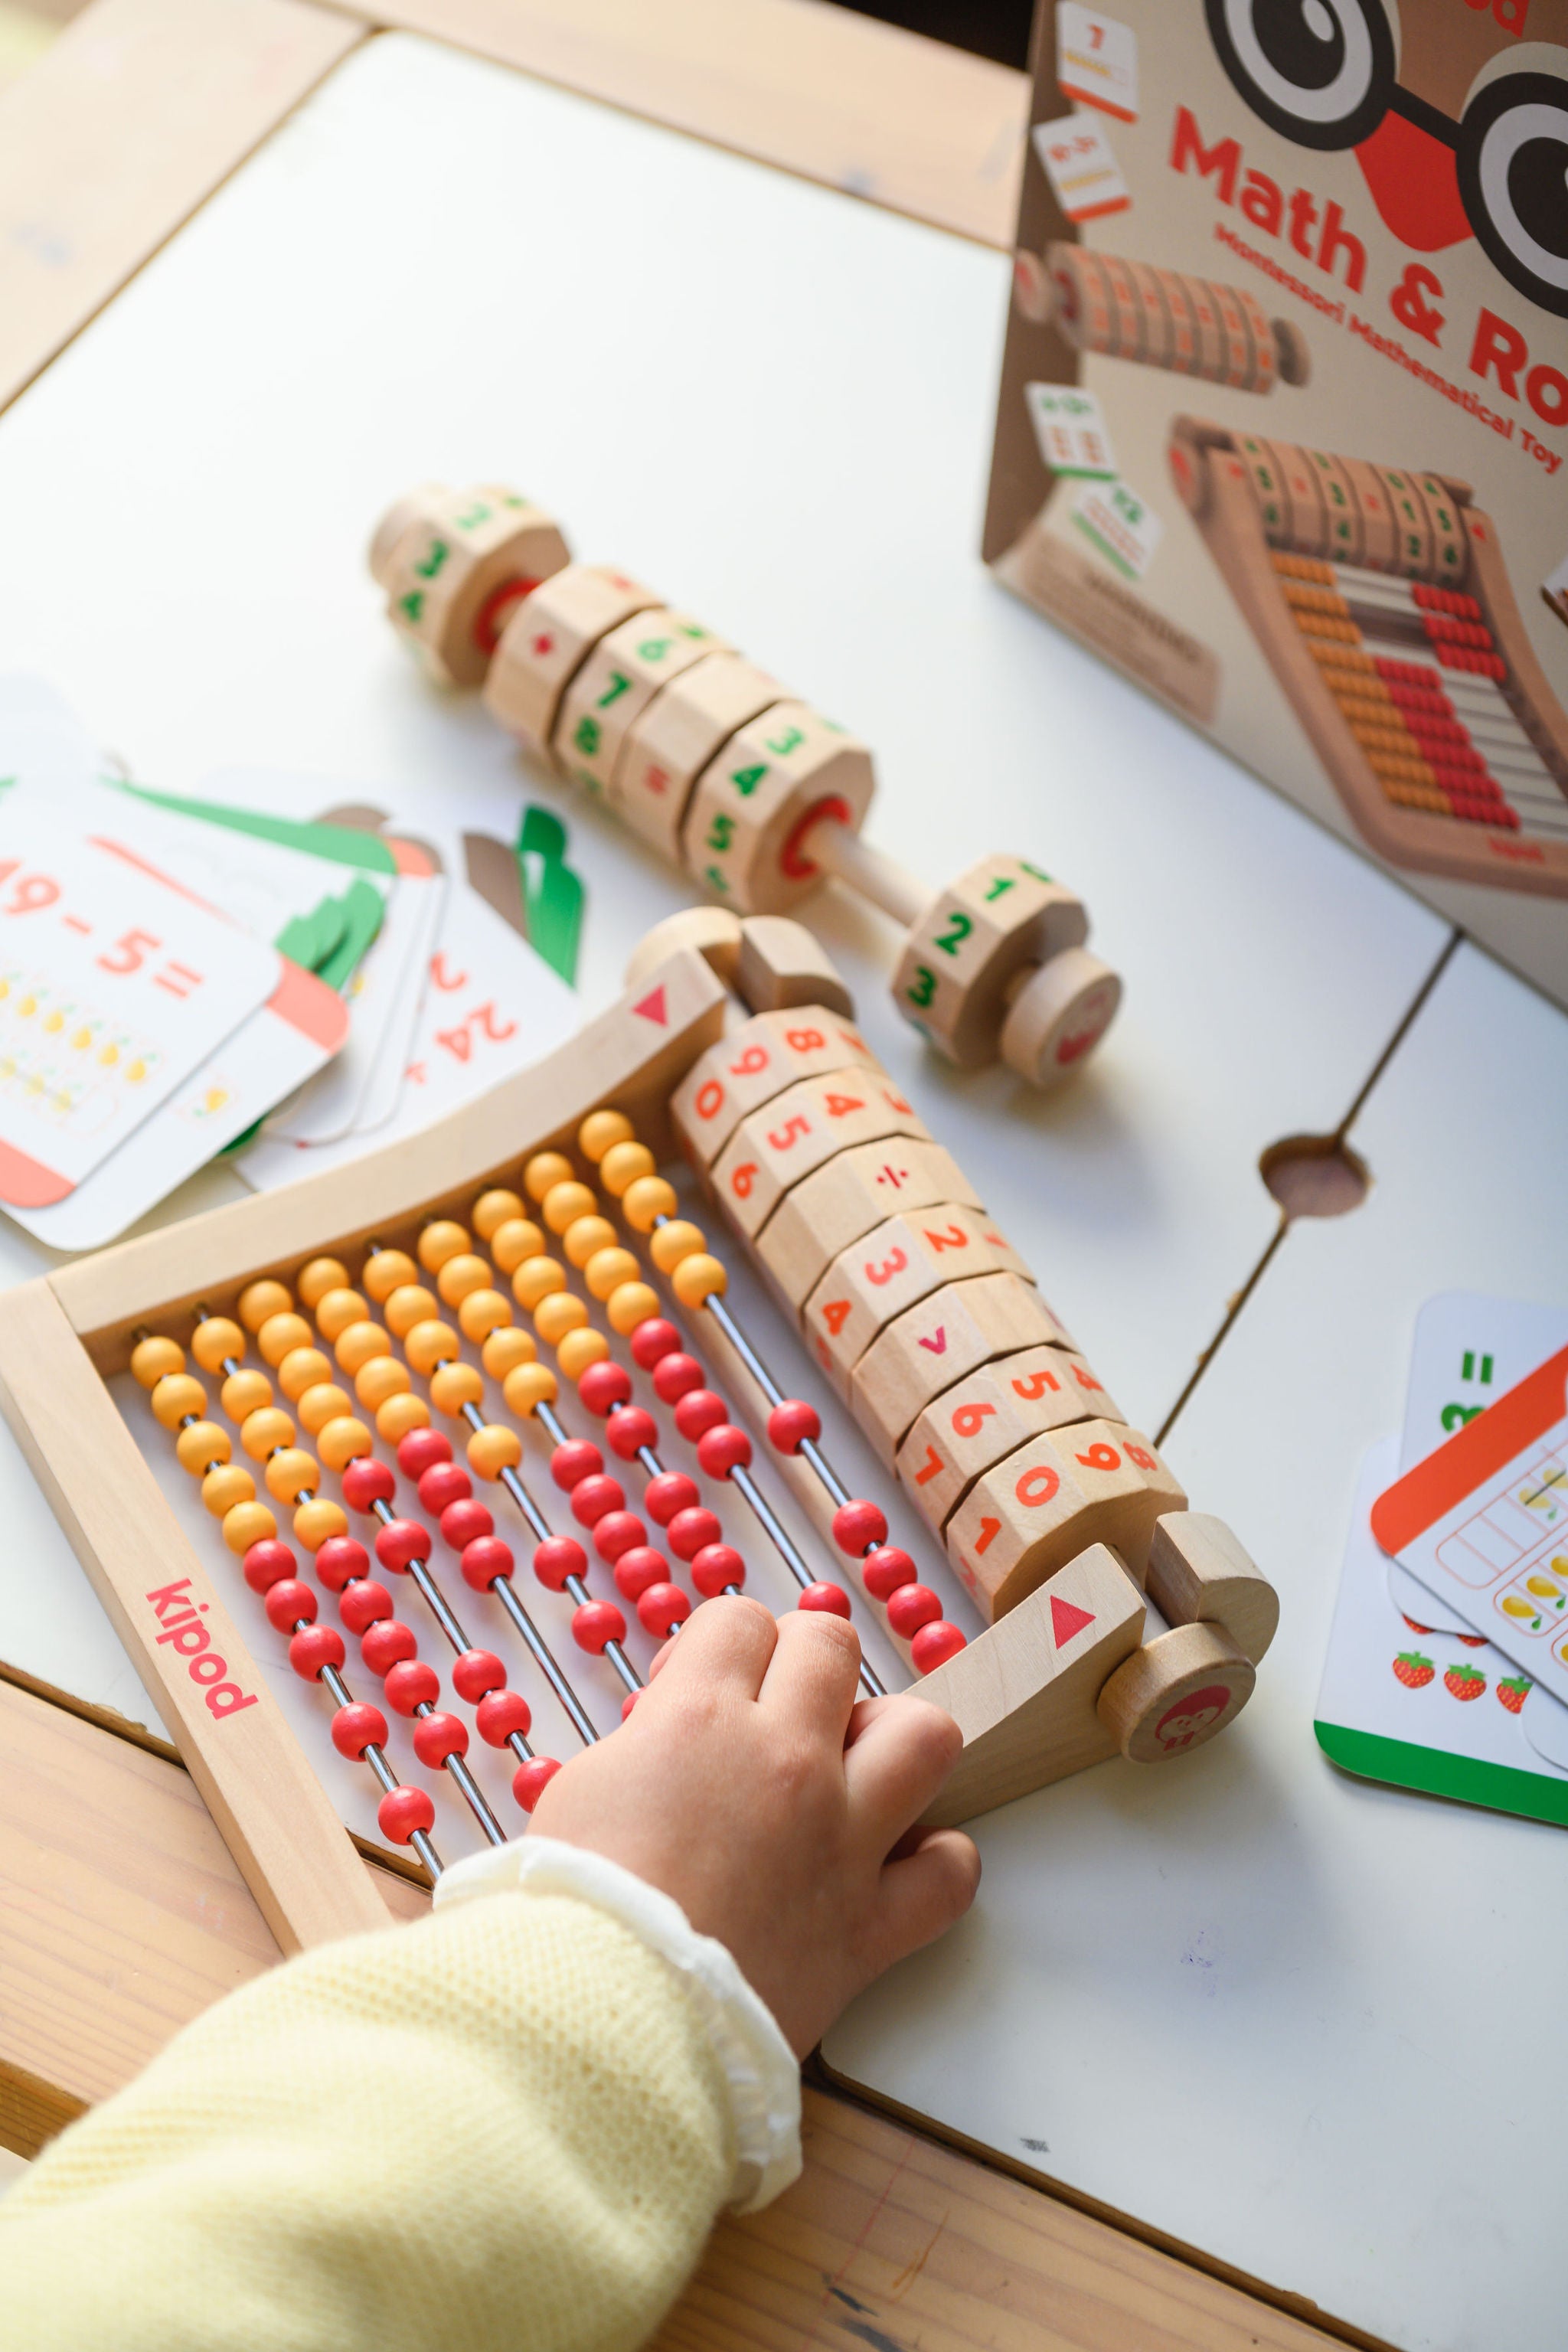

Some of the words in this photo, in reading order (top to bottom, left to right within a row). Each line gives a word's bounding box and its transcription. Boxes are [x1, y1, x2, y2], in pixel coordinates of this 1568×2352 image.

[1169, 103, 1367, 296] Math
[1389, 263, 1446, 349] &
[1468, 306, 1568, 428] Ro
[1214, 221, 1345, 325] Montessori
[1348, 313, 1514, 441] Mathematical
[1520, 427, 1563, 475] Toy
[769, 730, 804, 756] 3
[733, 766, 768, 797] 4
[710, 815, 735, 851] 5
[987, 880, 1014, 902] 1
[936, 914, 973, 956] 2
[910, 968, 936, 1008] 3
[786, 1029, 826, 1054] 8
[826, 1095, 865, 1118] 4
[926, 1227, 969, 1253] 2
[1012, 1371, 1061, 1400] 5
[1074, 1442, 1122, 1472] 9
[730, 1047, 770, 1076] 9
[768, 1116, 812, 1152] 5
[866, 1247, 908, 1286] 3
[952, 1404, 996, 1438] 6
[1016, 1467, 1060, 1508] 0
[696, 1081, 724, 1120] 0
[733, 1164, 759, 1199] 6
[823, 1301, 852, 1336] 4
[916, 1446, 945, 1486] 7
[975, 1517, 1001, 1556] 1
[1122, 1441, 1158, 1472] 8
[145, 1577, 259, 1720] kipod
